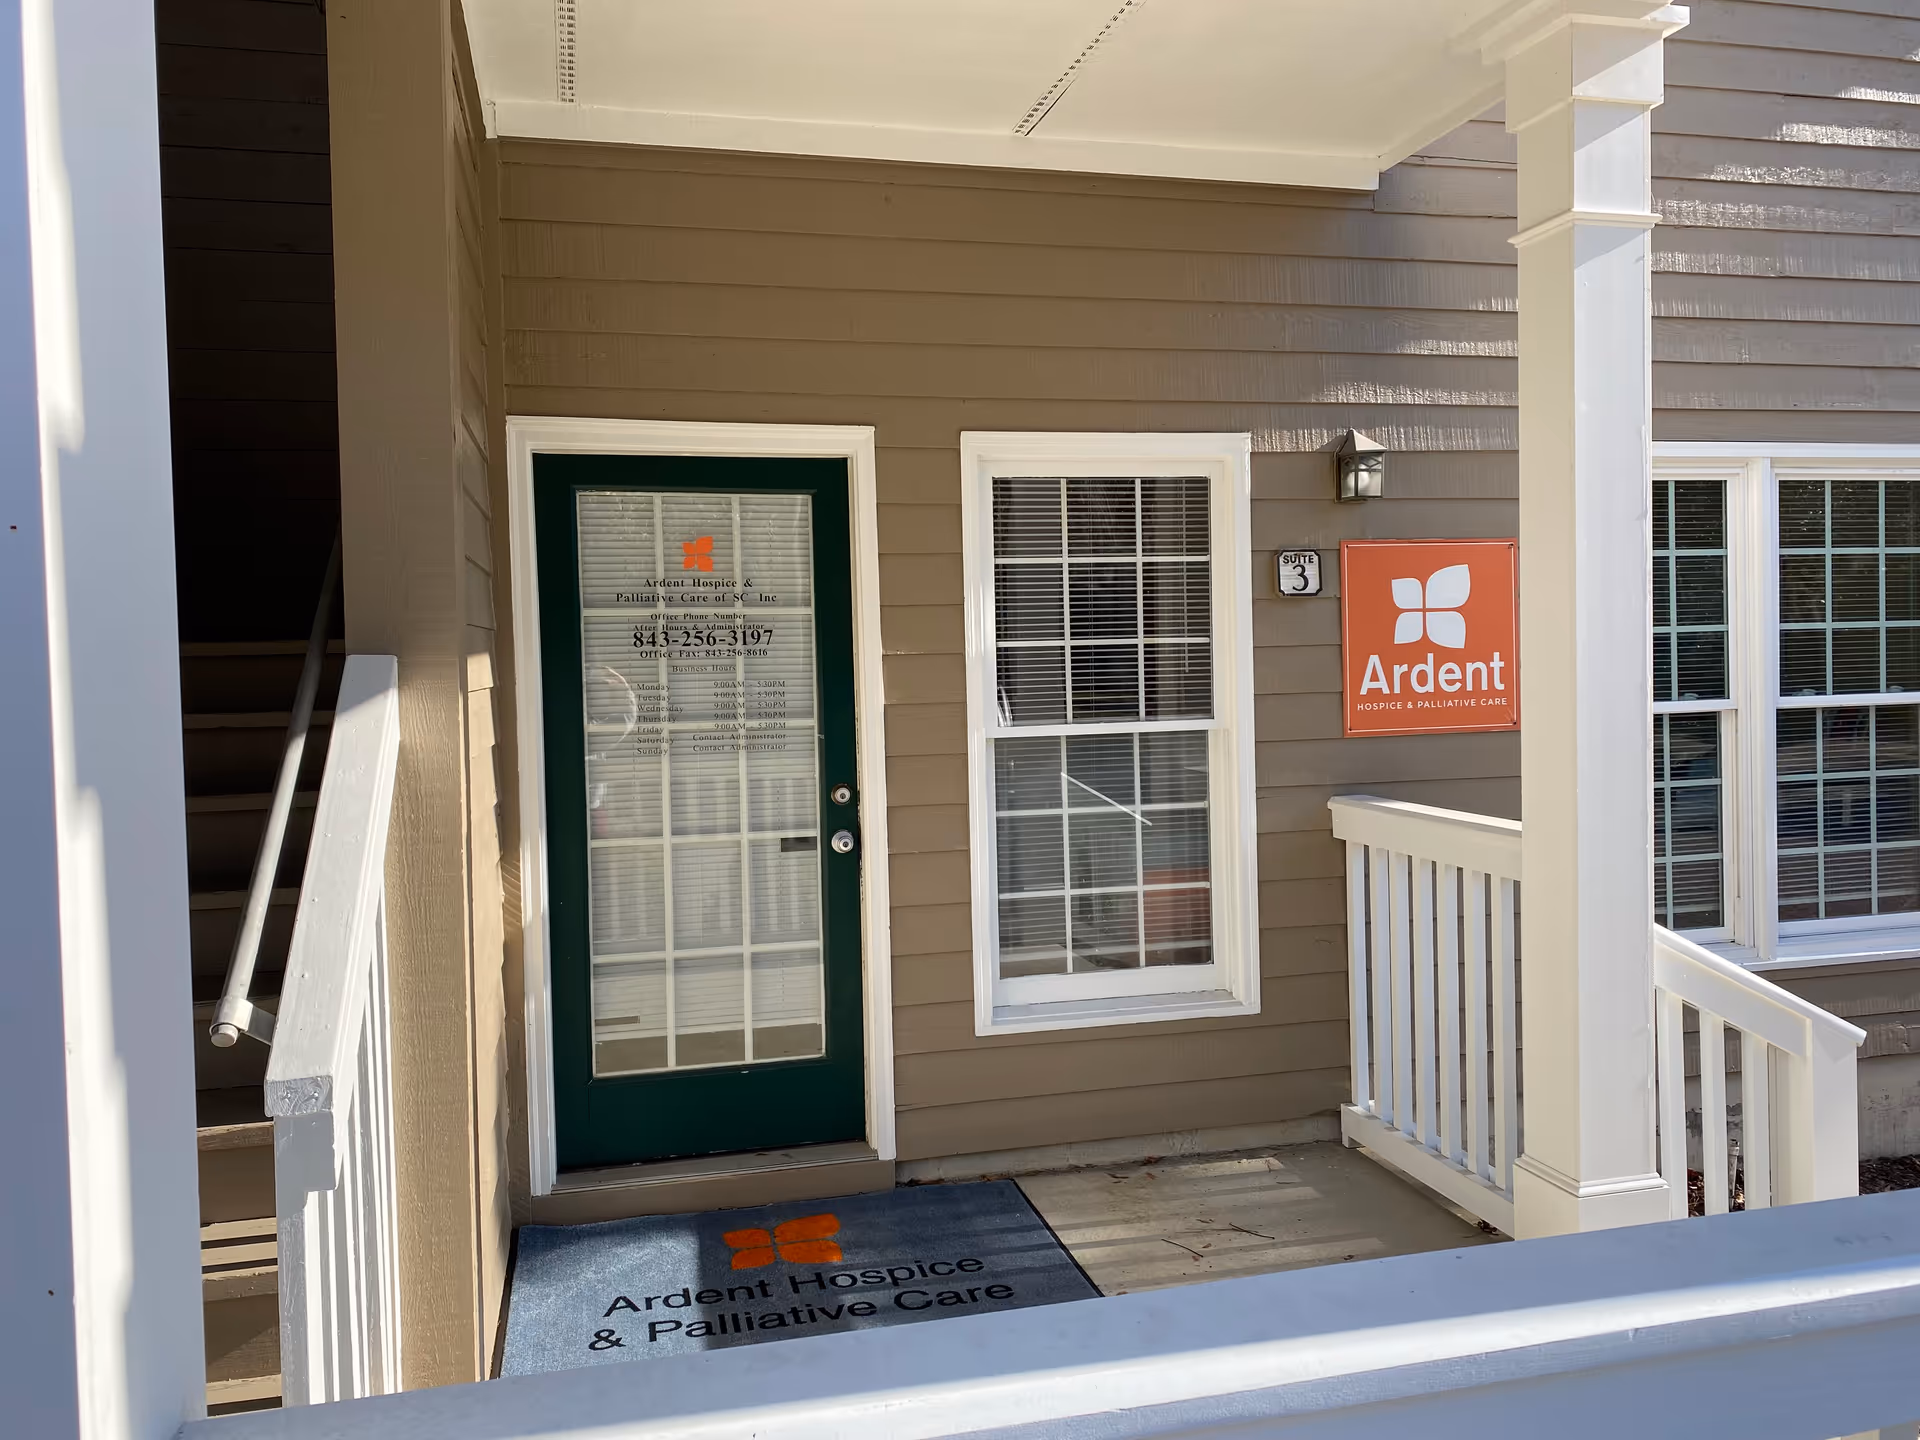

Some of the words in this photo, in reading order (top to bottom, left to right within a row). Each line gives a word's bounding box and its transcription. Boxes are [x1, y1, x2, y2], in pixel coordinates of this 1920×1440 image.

[1282, 554, 1314, 564] SUITE
[1292, 564, 1309, 592] 3
[644, 579, 684, 588] Ardent
[692, 579, 737, 590] Hospice
[744, 579, 753, 588] &
[616, 593, 673, 602] Palliative
[680, 593, 708, 602] Care
[715, 593, 726, 602] of
[759, 593, 777, 602] Inc
[650, 613, 678, 621] Office
[633, 630, 773, 648] 843-256-3197
[679, 650, 700, 658] Fax:
[705, 648, 768, 657] 843-256-8616
[672, 665, 707, 673] Business
[1360, 652, 1505, 695] Ardent
[637, 684, 670, 692] Monday
[637, 705, 684, 713] Wednesday
[1357, 702, 1403, 711] HOSPICE
[1407, 701, 1414, 709] &
[1418, 699, 1477, 708] PALLIATIVE
[1480, 698, 1507, 706] CARE
[637, 726, 664, 734] Friday
[603, 1279, 774, 1317] Ardent
[791, 1256, 985, 1294] Hospice
[588, 1328, 626, 1352] &
[649, 1298, 877, 1343] Palliative
[893, 1282, 1015, 1311] Care
